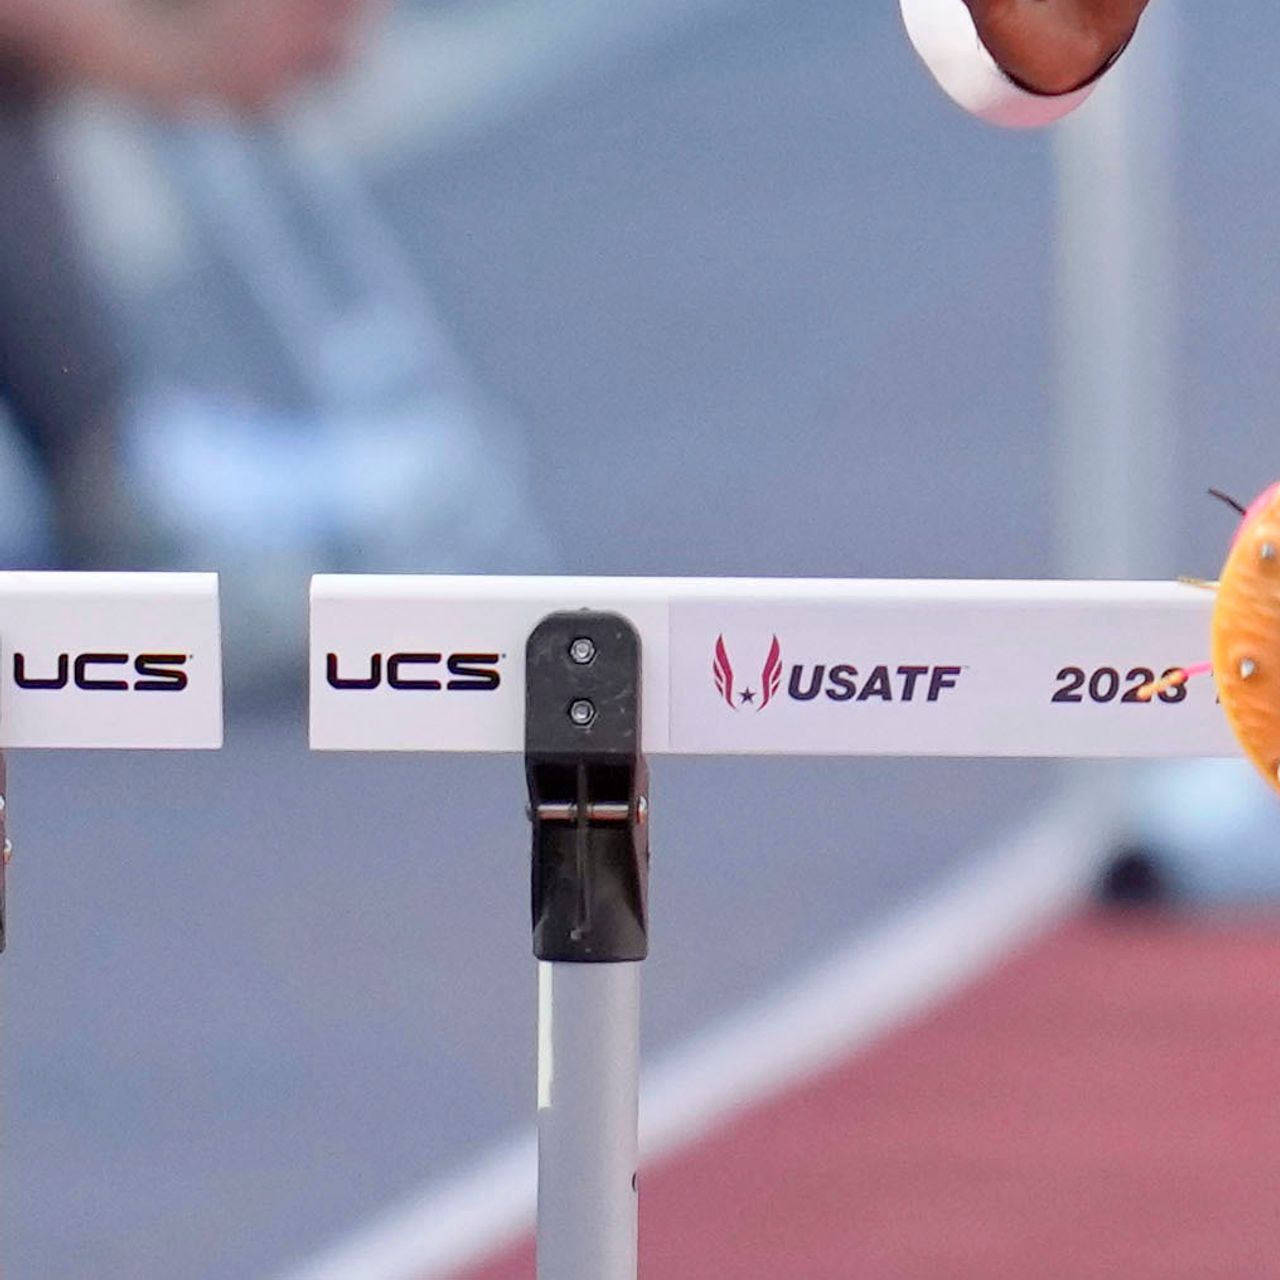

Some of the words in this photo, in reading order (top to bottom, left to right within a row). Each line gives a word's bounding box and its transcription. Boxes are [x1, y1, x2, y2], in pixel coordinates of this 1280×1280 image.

[13, 652, 190, 691] UCS
[325, 652, 502, 691] UCS
[786, 663, 962, 703] USATF
[1050, 666, 1188, 704] 2023
